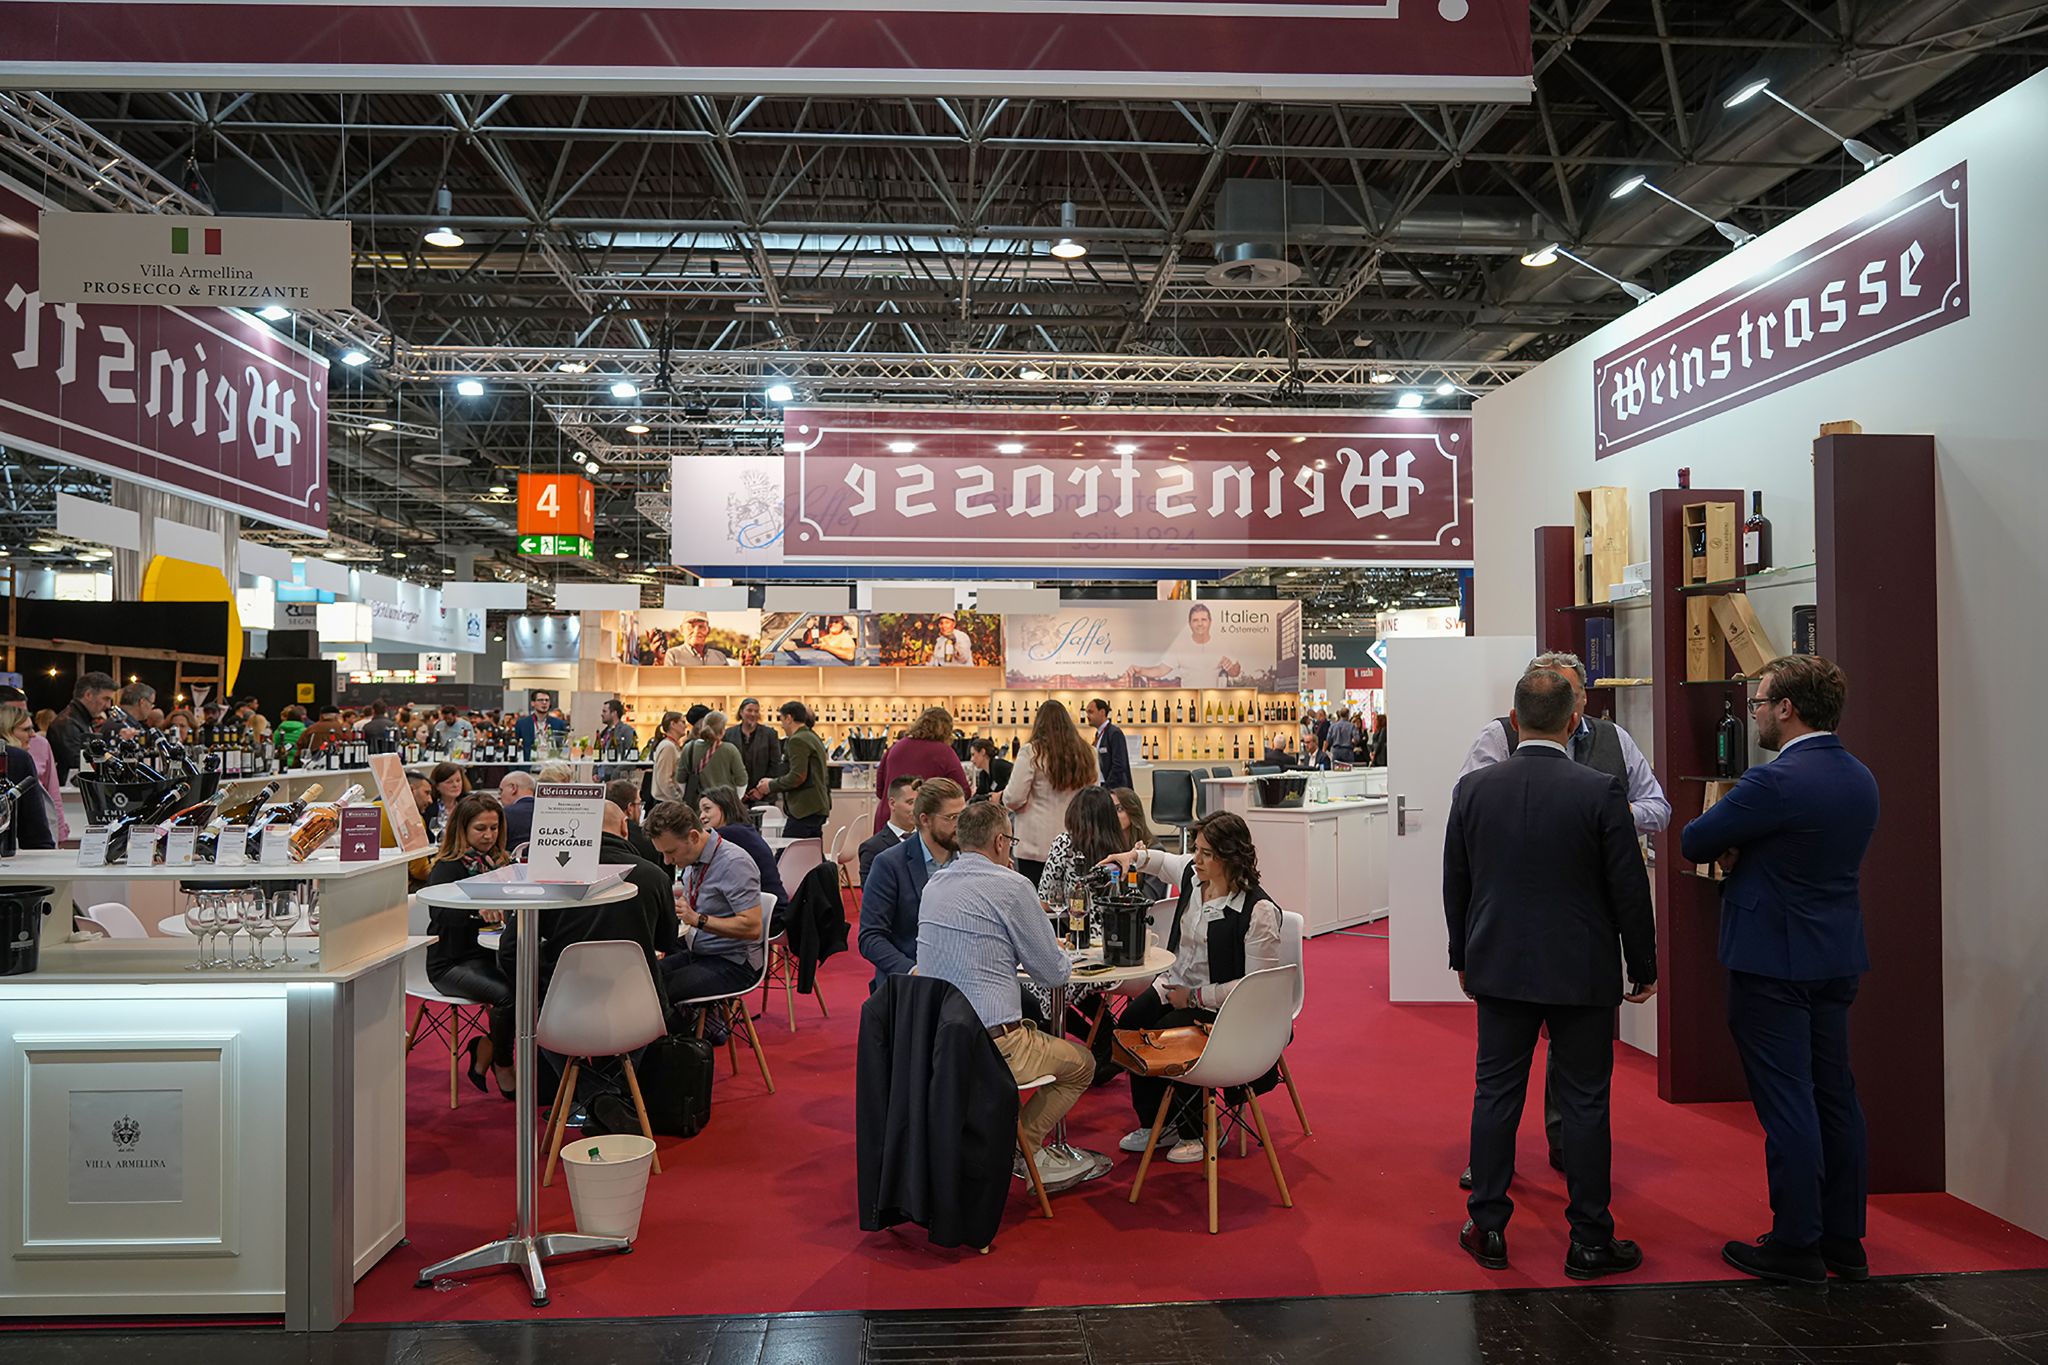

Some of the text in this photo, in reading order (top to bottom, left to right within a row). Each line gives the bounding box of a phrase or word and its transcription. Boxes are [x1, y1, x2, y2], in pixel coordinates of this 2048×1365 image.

[140, 264, 254, 280] Villa Armellina
[83, 281, 309, 299] PROSECCO & FRIZZANTE
[1611, 239, 1925, 421] Weinstrasse
[536, 484, 560, 518] 4
[1221, 609, 1269, 623] Italien
[1308, 643, 1337, 660] 1886.
[539, 827, 568, 836] GLAS-
[537, 838, 593, 847] RÜCKGABE
[85, 1160, 111, 1169] VILLA
